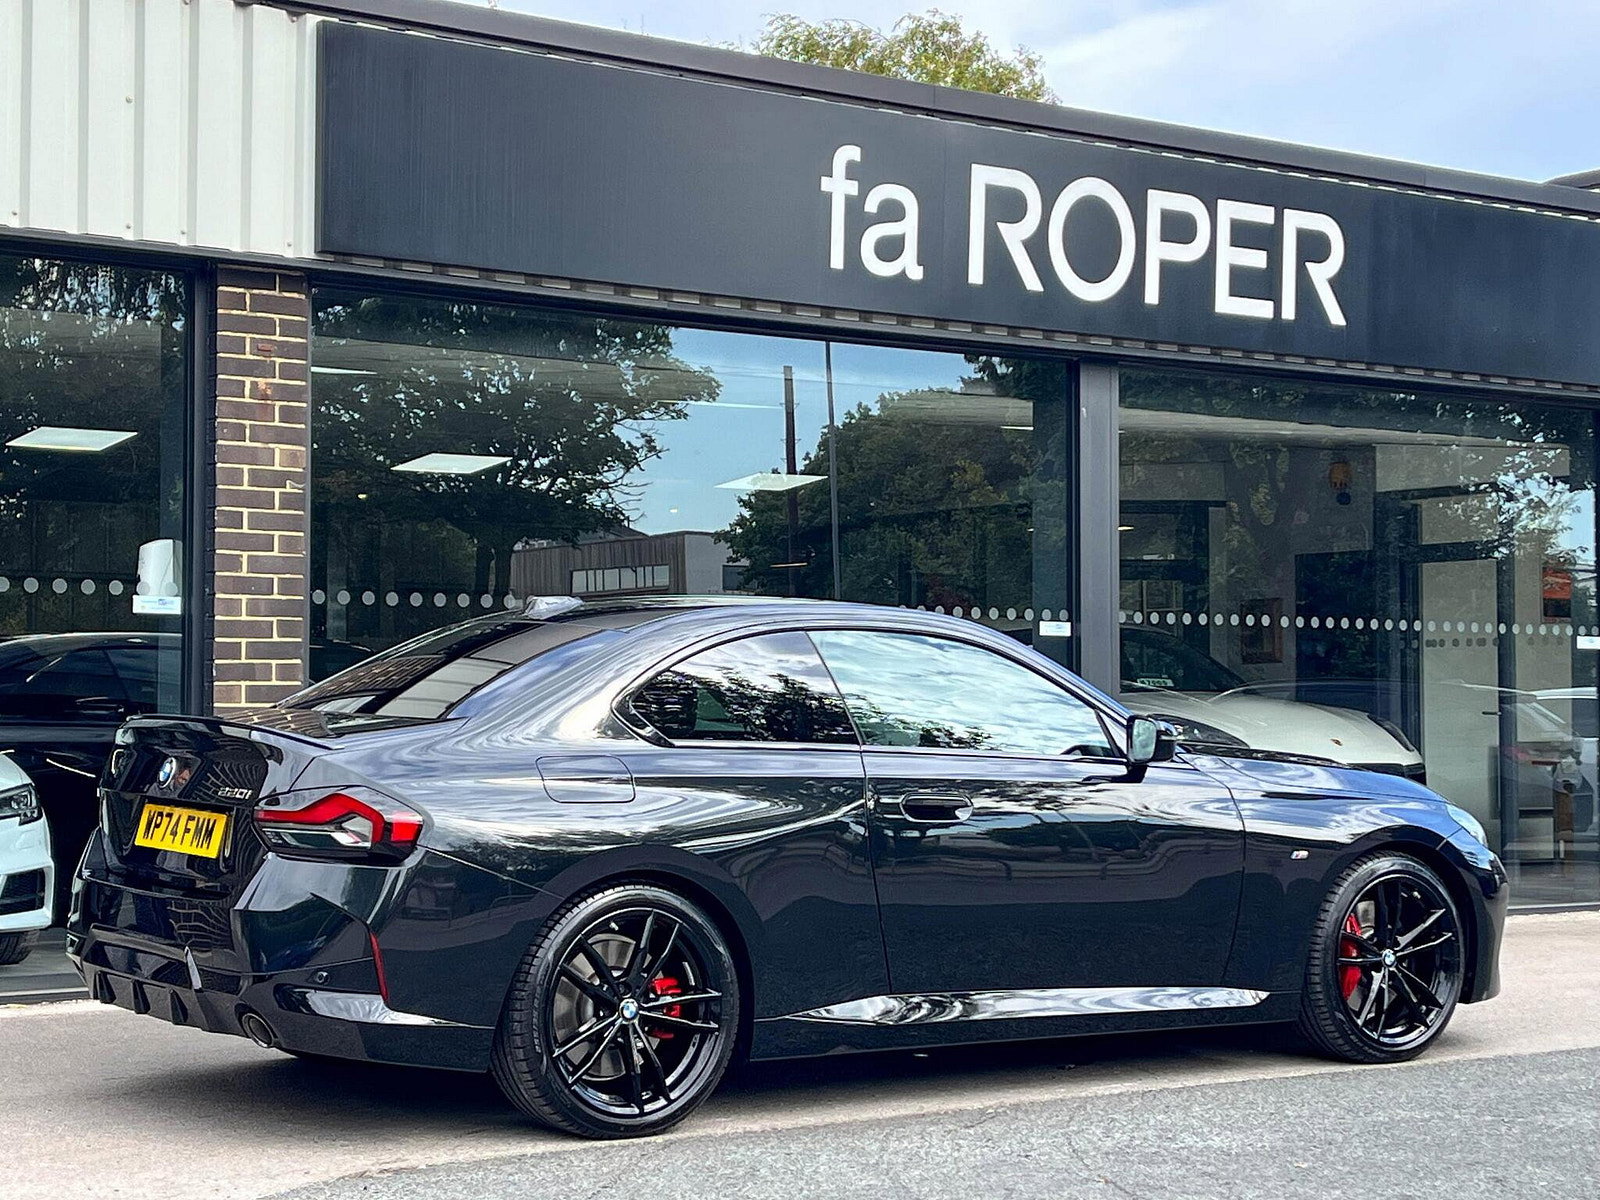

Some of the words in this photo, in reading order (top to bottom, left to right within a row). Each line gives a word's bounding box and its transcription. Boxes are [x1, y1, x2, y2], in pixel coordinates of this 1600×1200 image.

[820, 144, 923, 280] fa
[967, 162, 1347, 326] ROPER
[142, 809, 182, 845] WP74
[180, 814, 217, 850] FMM
